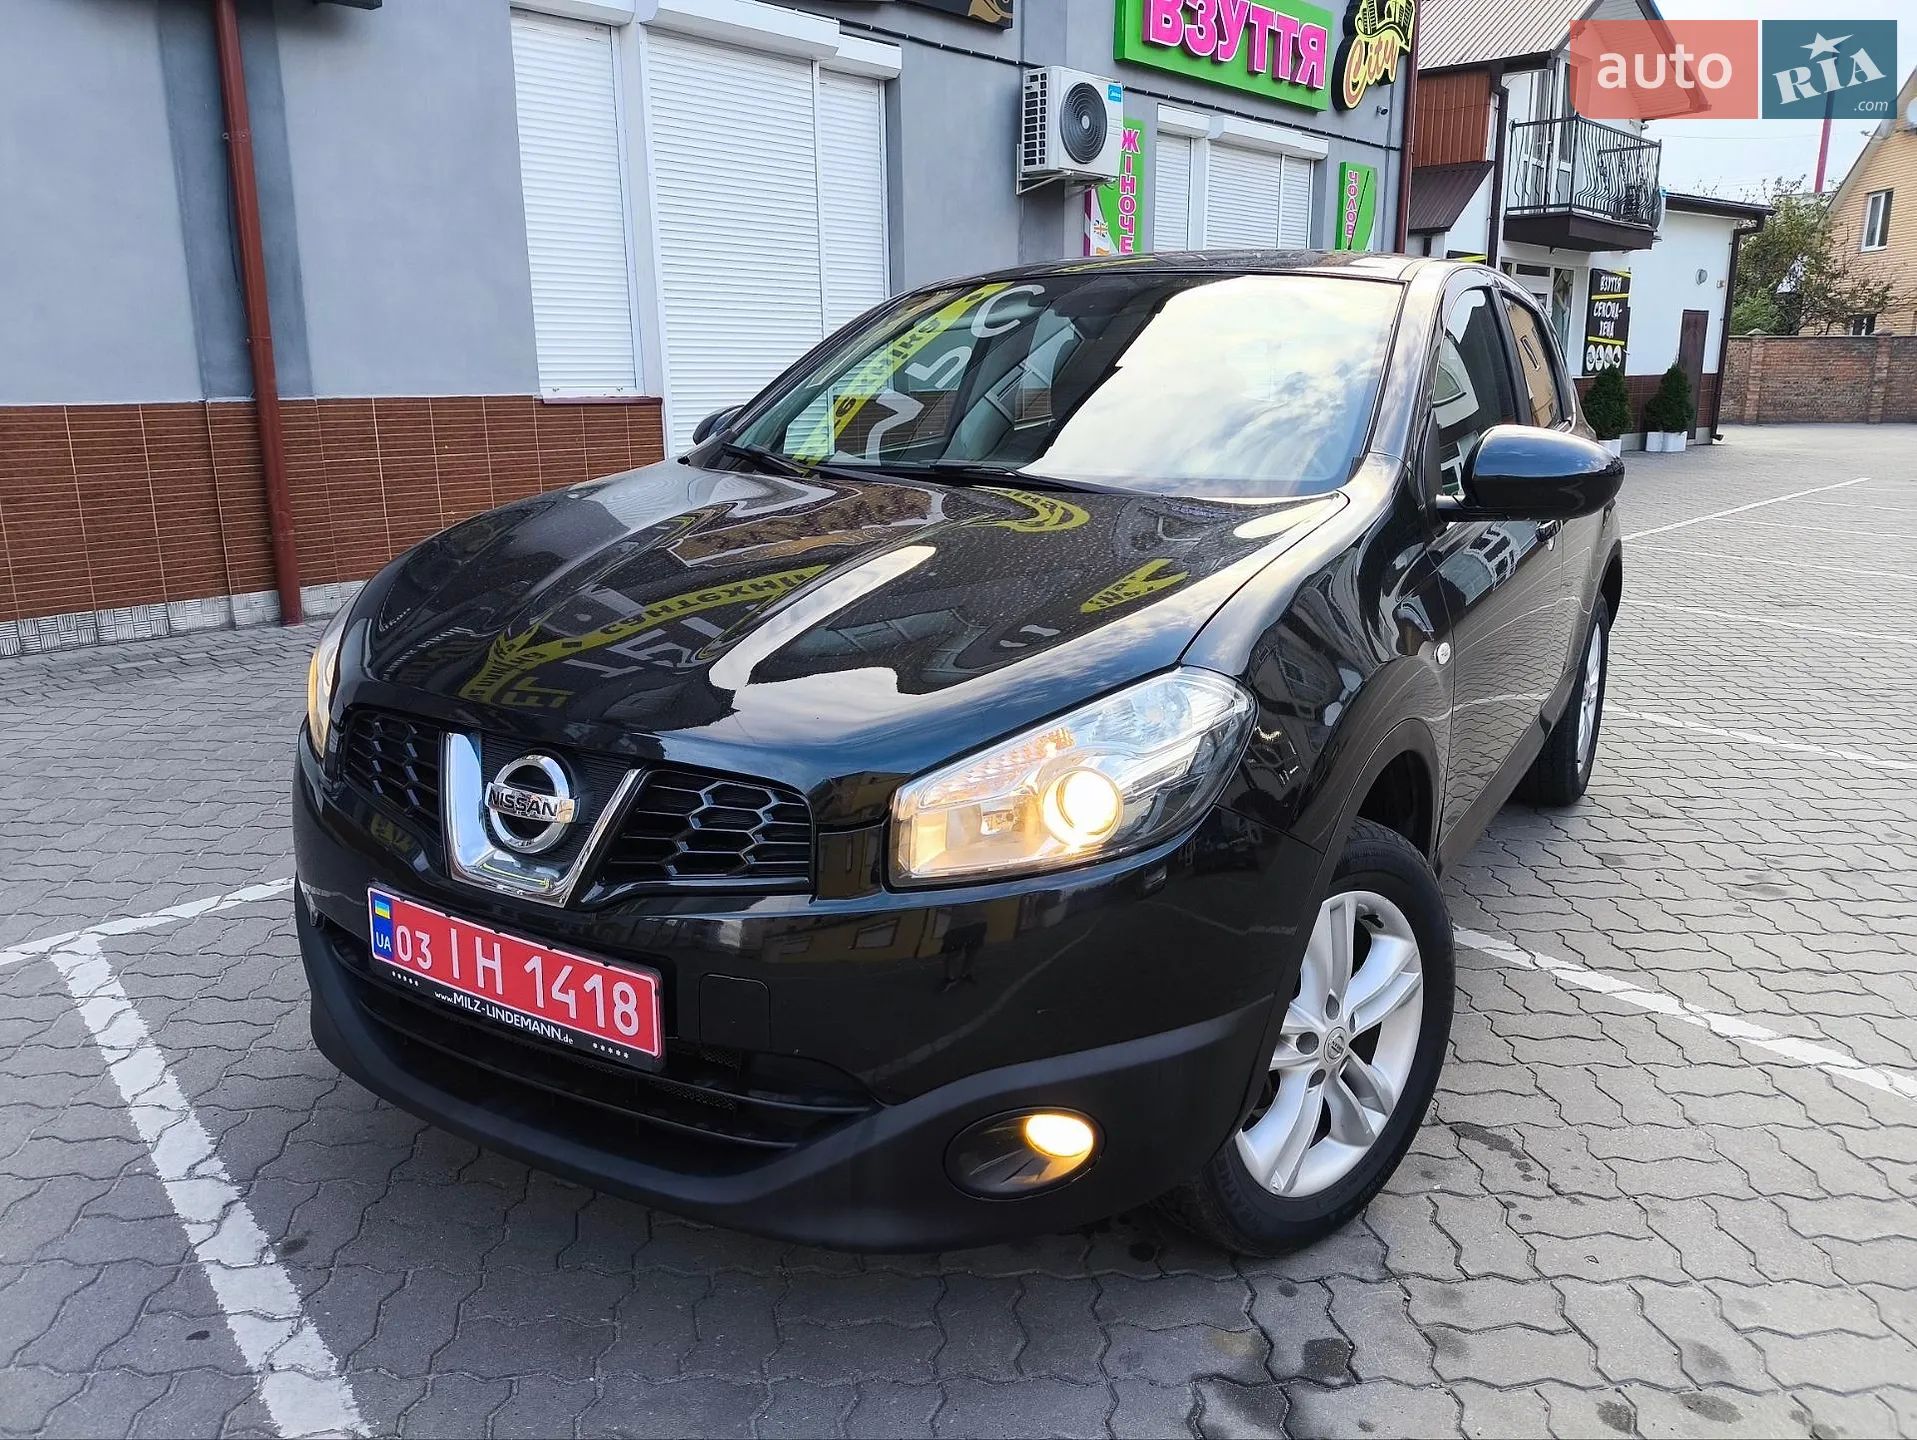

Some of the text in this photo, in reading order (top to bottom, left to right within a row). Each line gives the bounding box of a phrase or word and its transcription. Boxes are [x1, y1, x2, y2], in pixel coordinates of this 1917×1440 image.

[1144, 0, 1328, 90] ВЗУТТЯ
[1343, 36, 1399, 108] City
[1118, 128, 1140, 254] ЖІНОЧЕ
[1600, 275, 1622, 292] ВЗУТТЯ
[488, 785, 558, 817] NISSAN
[375, 931, 392, 953] UA
[396, 925, 433, 970] 03
[523, 955, 639, 1037] 1418
[434, 991, 574, 1045] www.MILZ-LINDEMANN.de
